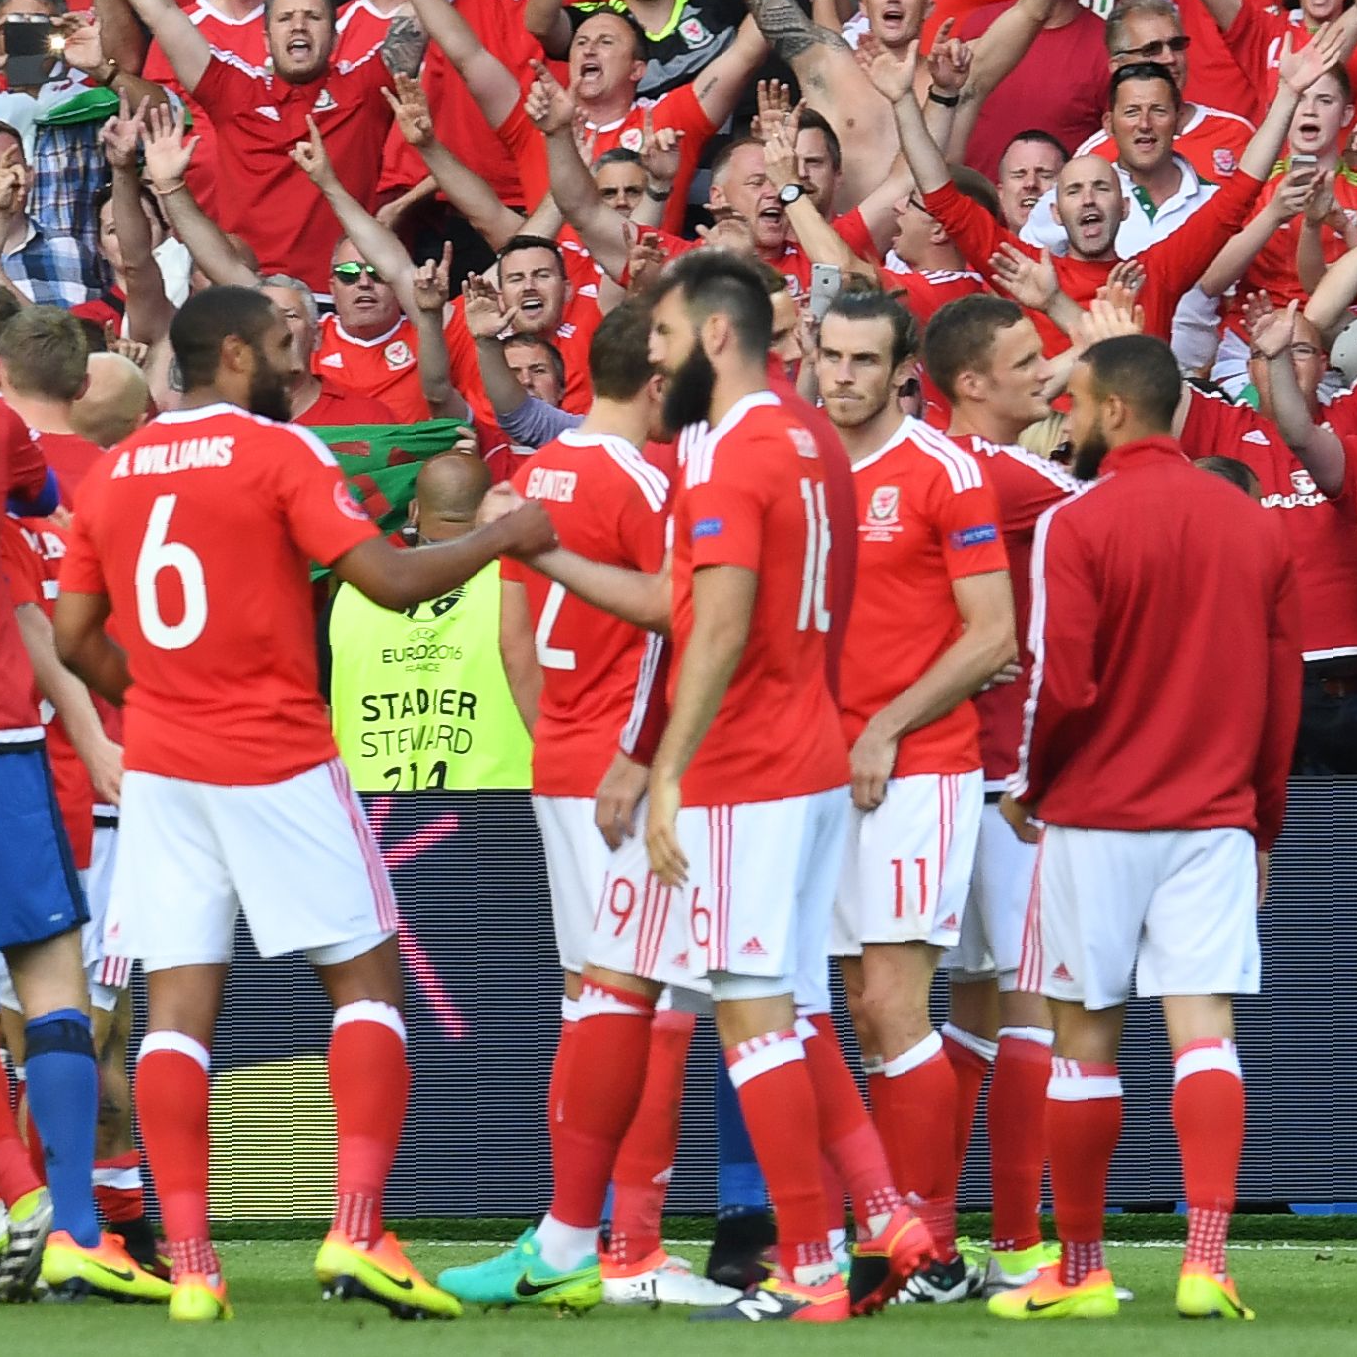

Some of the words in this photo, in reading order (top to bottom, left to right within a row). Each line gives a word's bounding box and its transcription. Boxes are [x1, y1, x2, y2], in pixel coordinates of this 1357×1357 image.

[133, 436, 235, 476] WILLIAMS
[525, 467, 578, 503] GUNTER
[134, 493, 209, 650] 6
[382, 644, 464, 664] EURO2016
[361, 688, 478, 722] STADIER
[360, 724, 473, 758] STEWARD
[891, 857, 929, 919] 11
